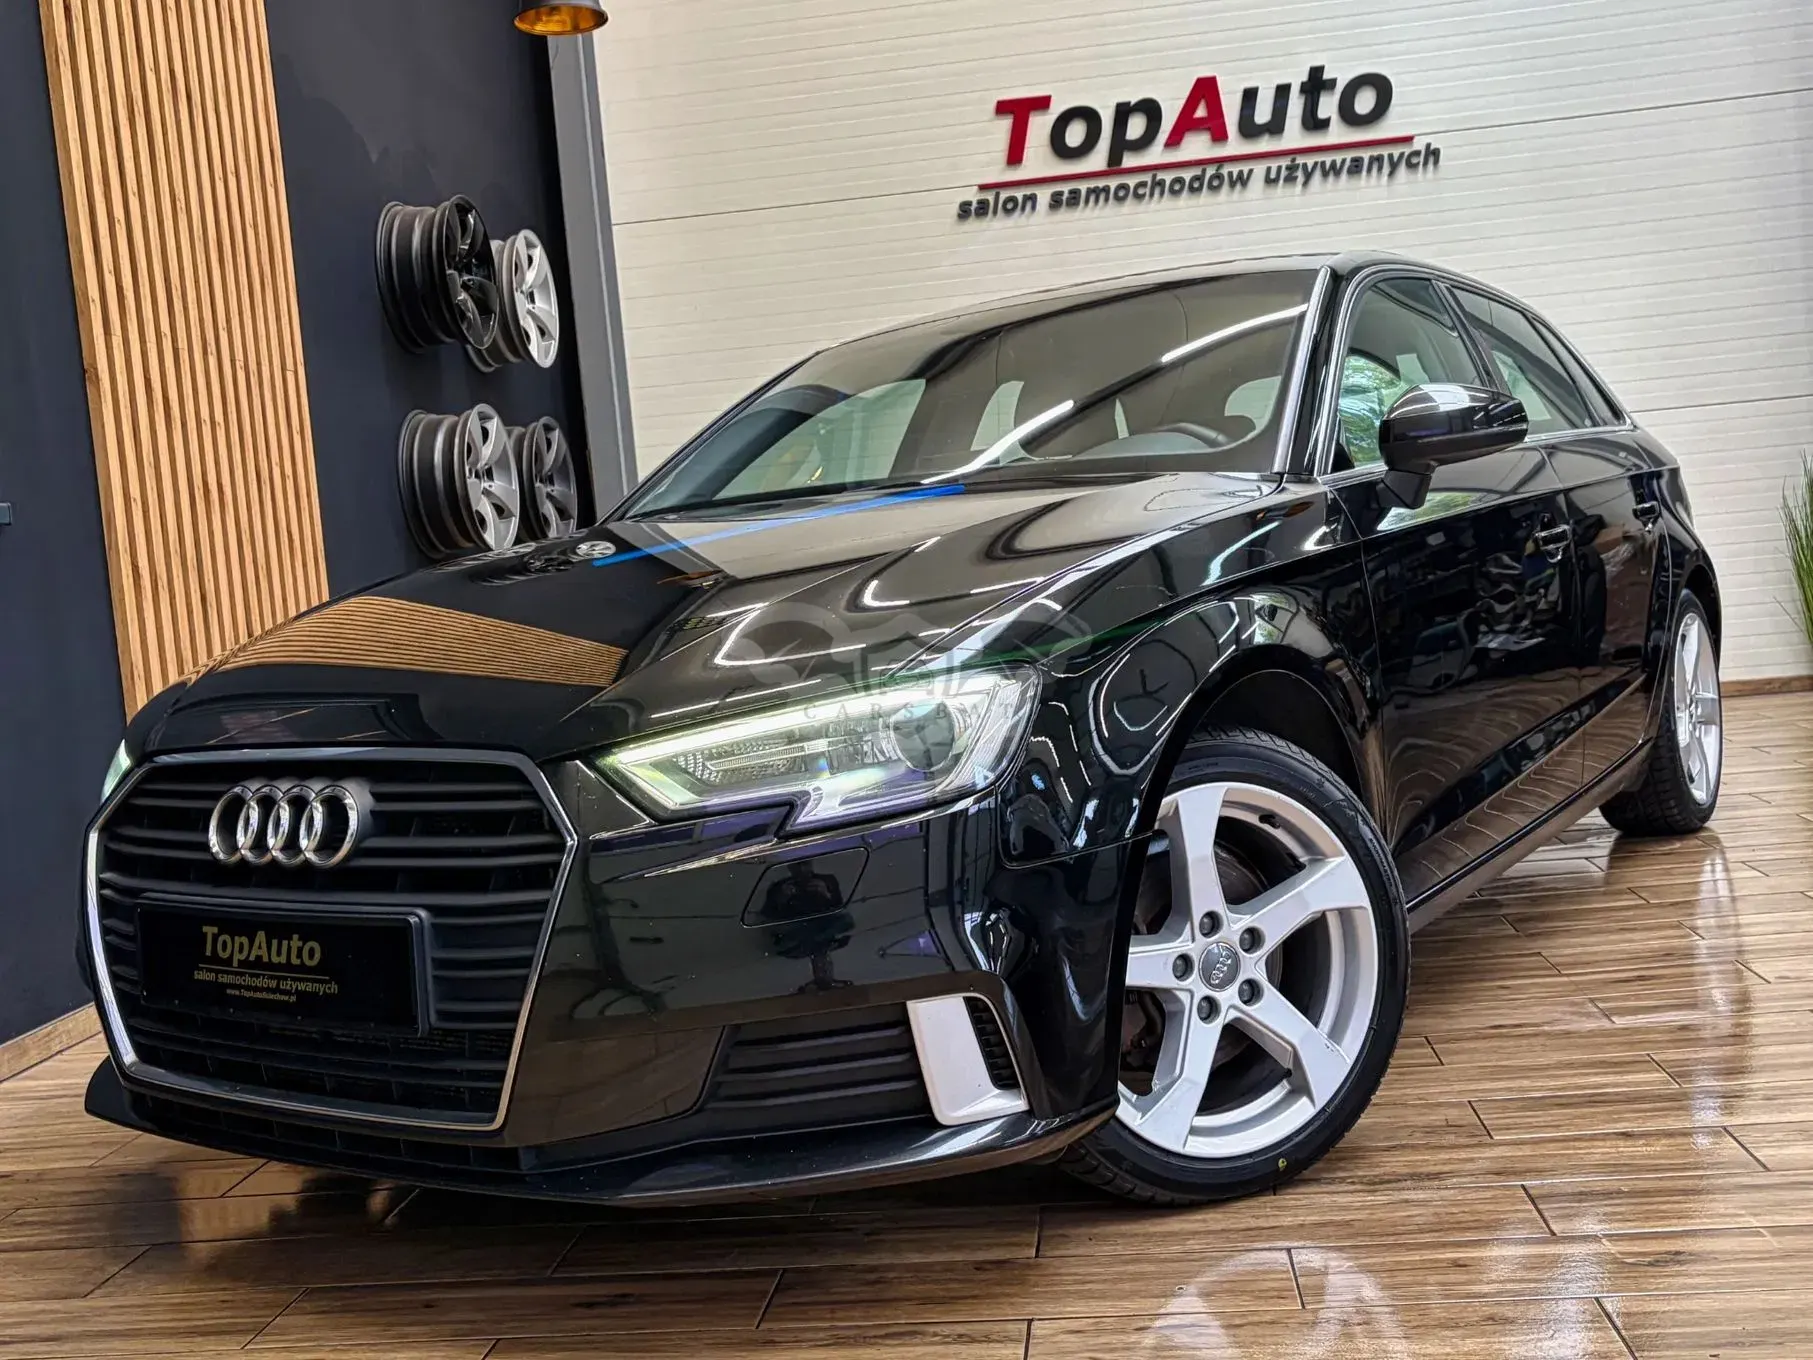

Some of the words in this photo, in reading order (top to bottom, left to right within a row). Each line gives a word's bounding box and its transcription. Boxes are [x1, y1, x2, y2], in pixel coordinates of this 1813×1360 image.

[995, 64, 1394, 167] TopAuto
[957, 190, 1038, 219] salon
[1048, 164, 1254, 211] samochodów
[1263, 142, 1442, 184] używanych
[202, 925, 321, 967] TopAuto
[194, 969, 216, 981] salon
[217, 972, 277, 989] samochodów
[280, 978, 338, 995] używanych
